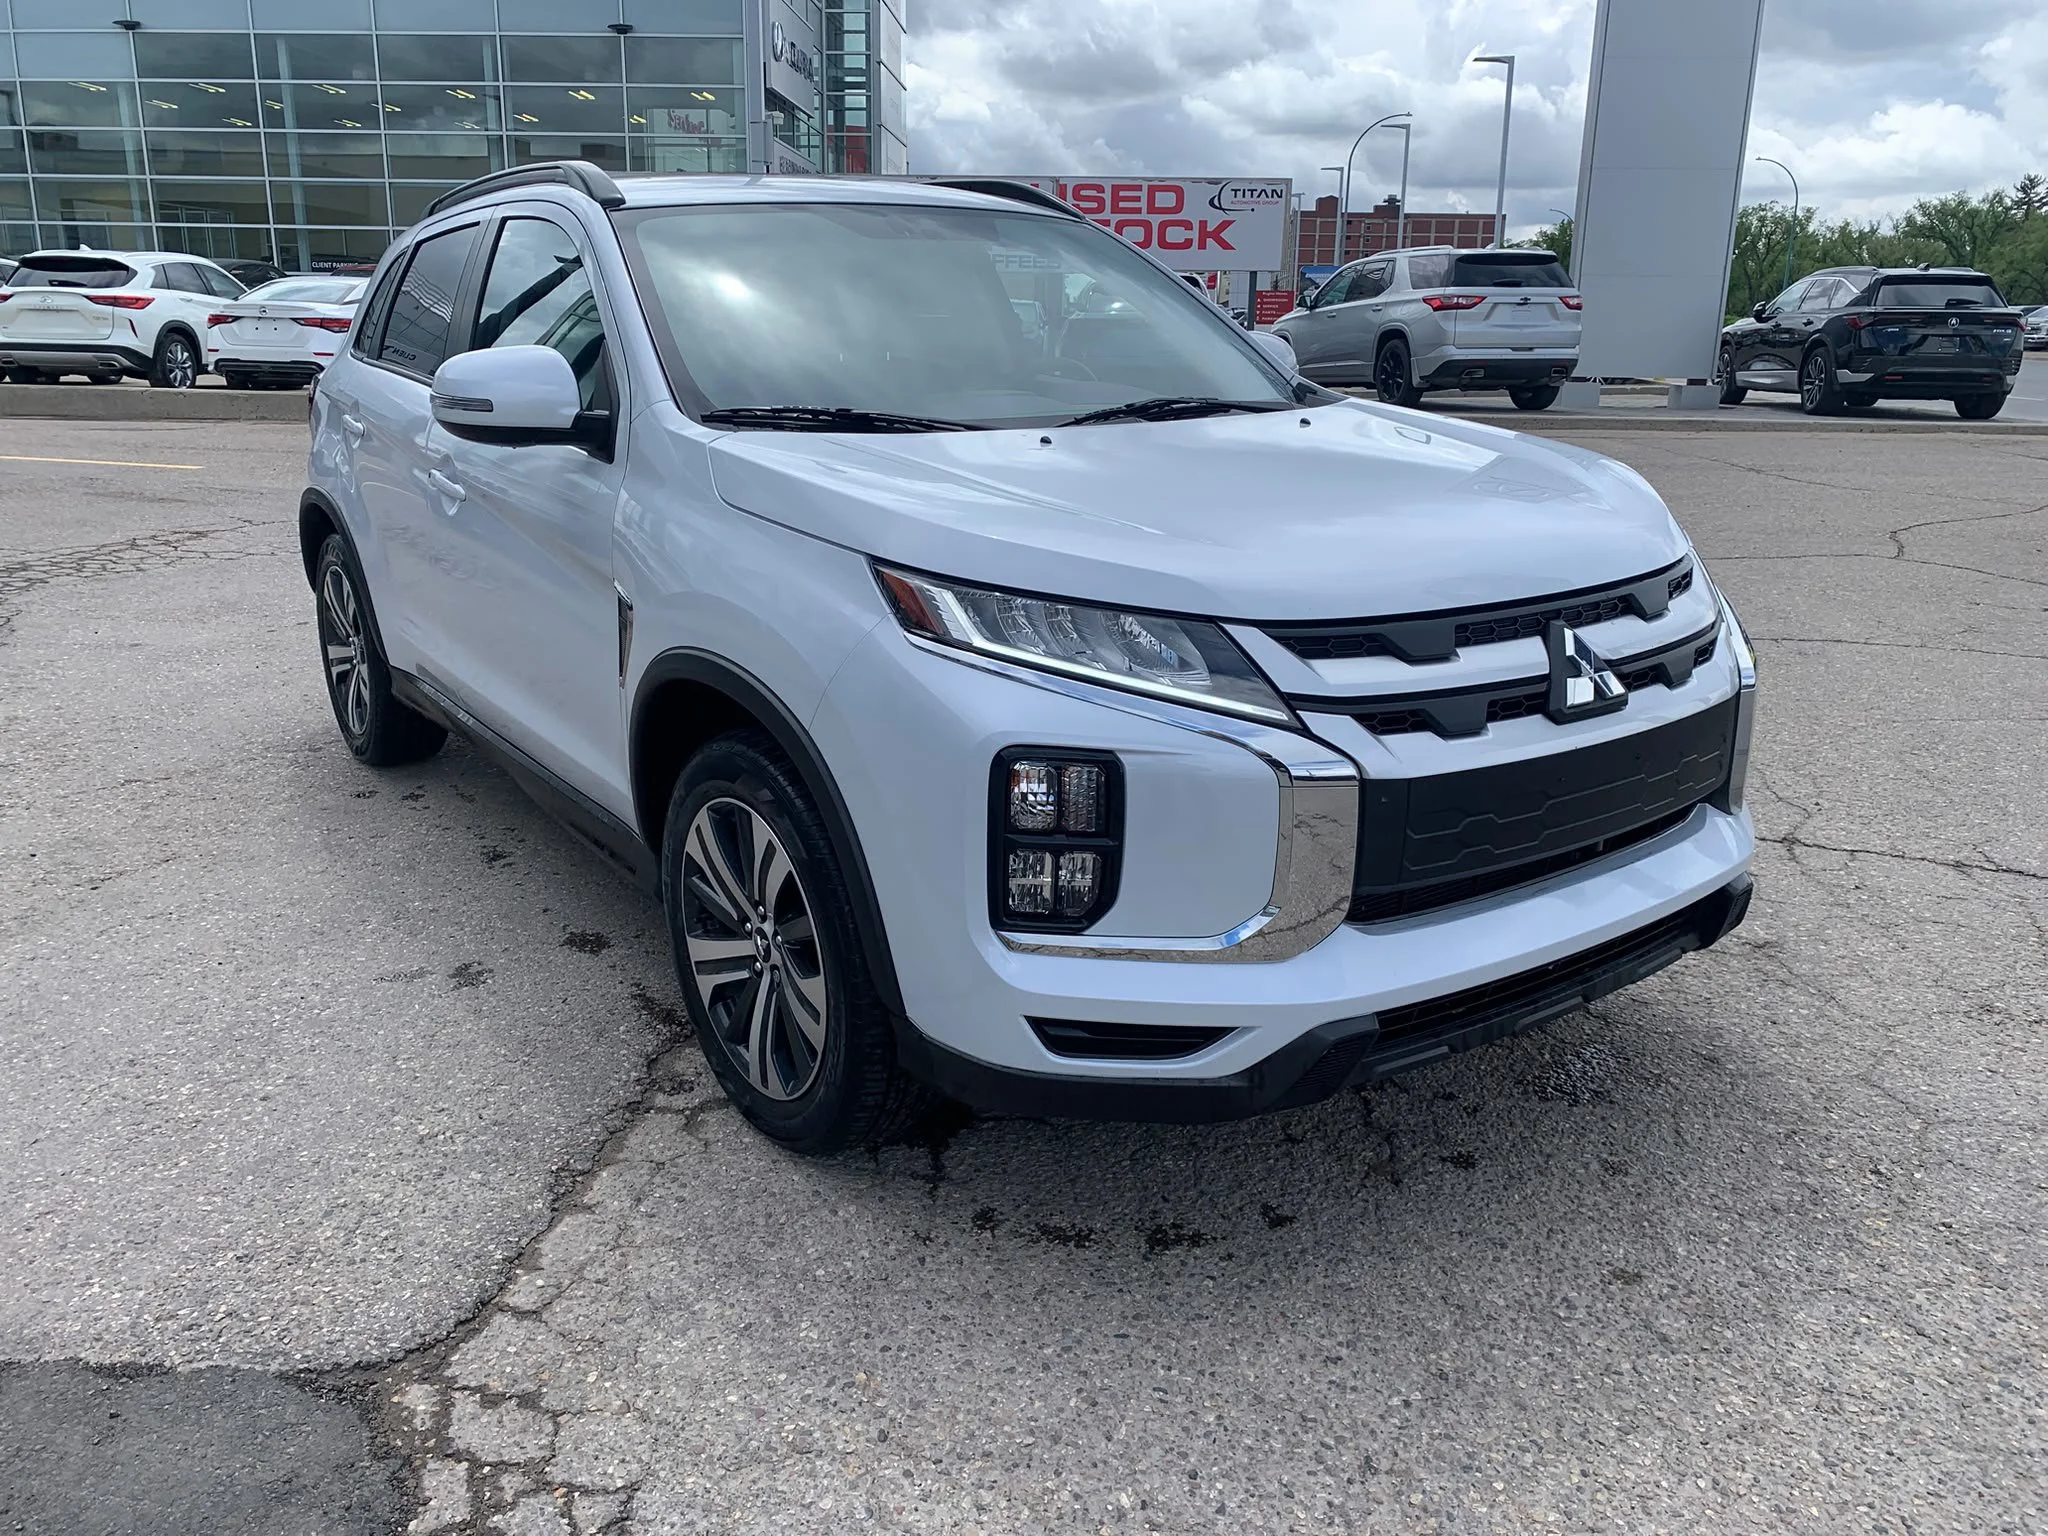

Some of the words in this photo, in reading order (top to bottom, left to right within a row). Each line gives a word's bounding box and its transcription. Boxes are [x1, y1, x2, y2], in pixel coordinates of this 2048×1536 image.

[1230, 188, 1284, 199] TITAN
[1088, 218, 1237, 250] OCK
[311, 261, 332, 269] CLIENT
